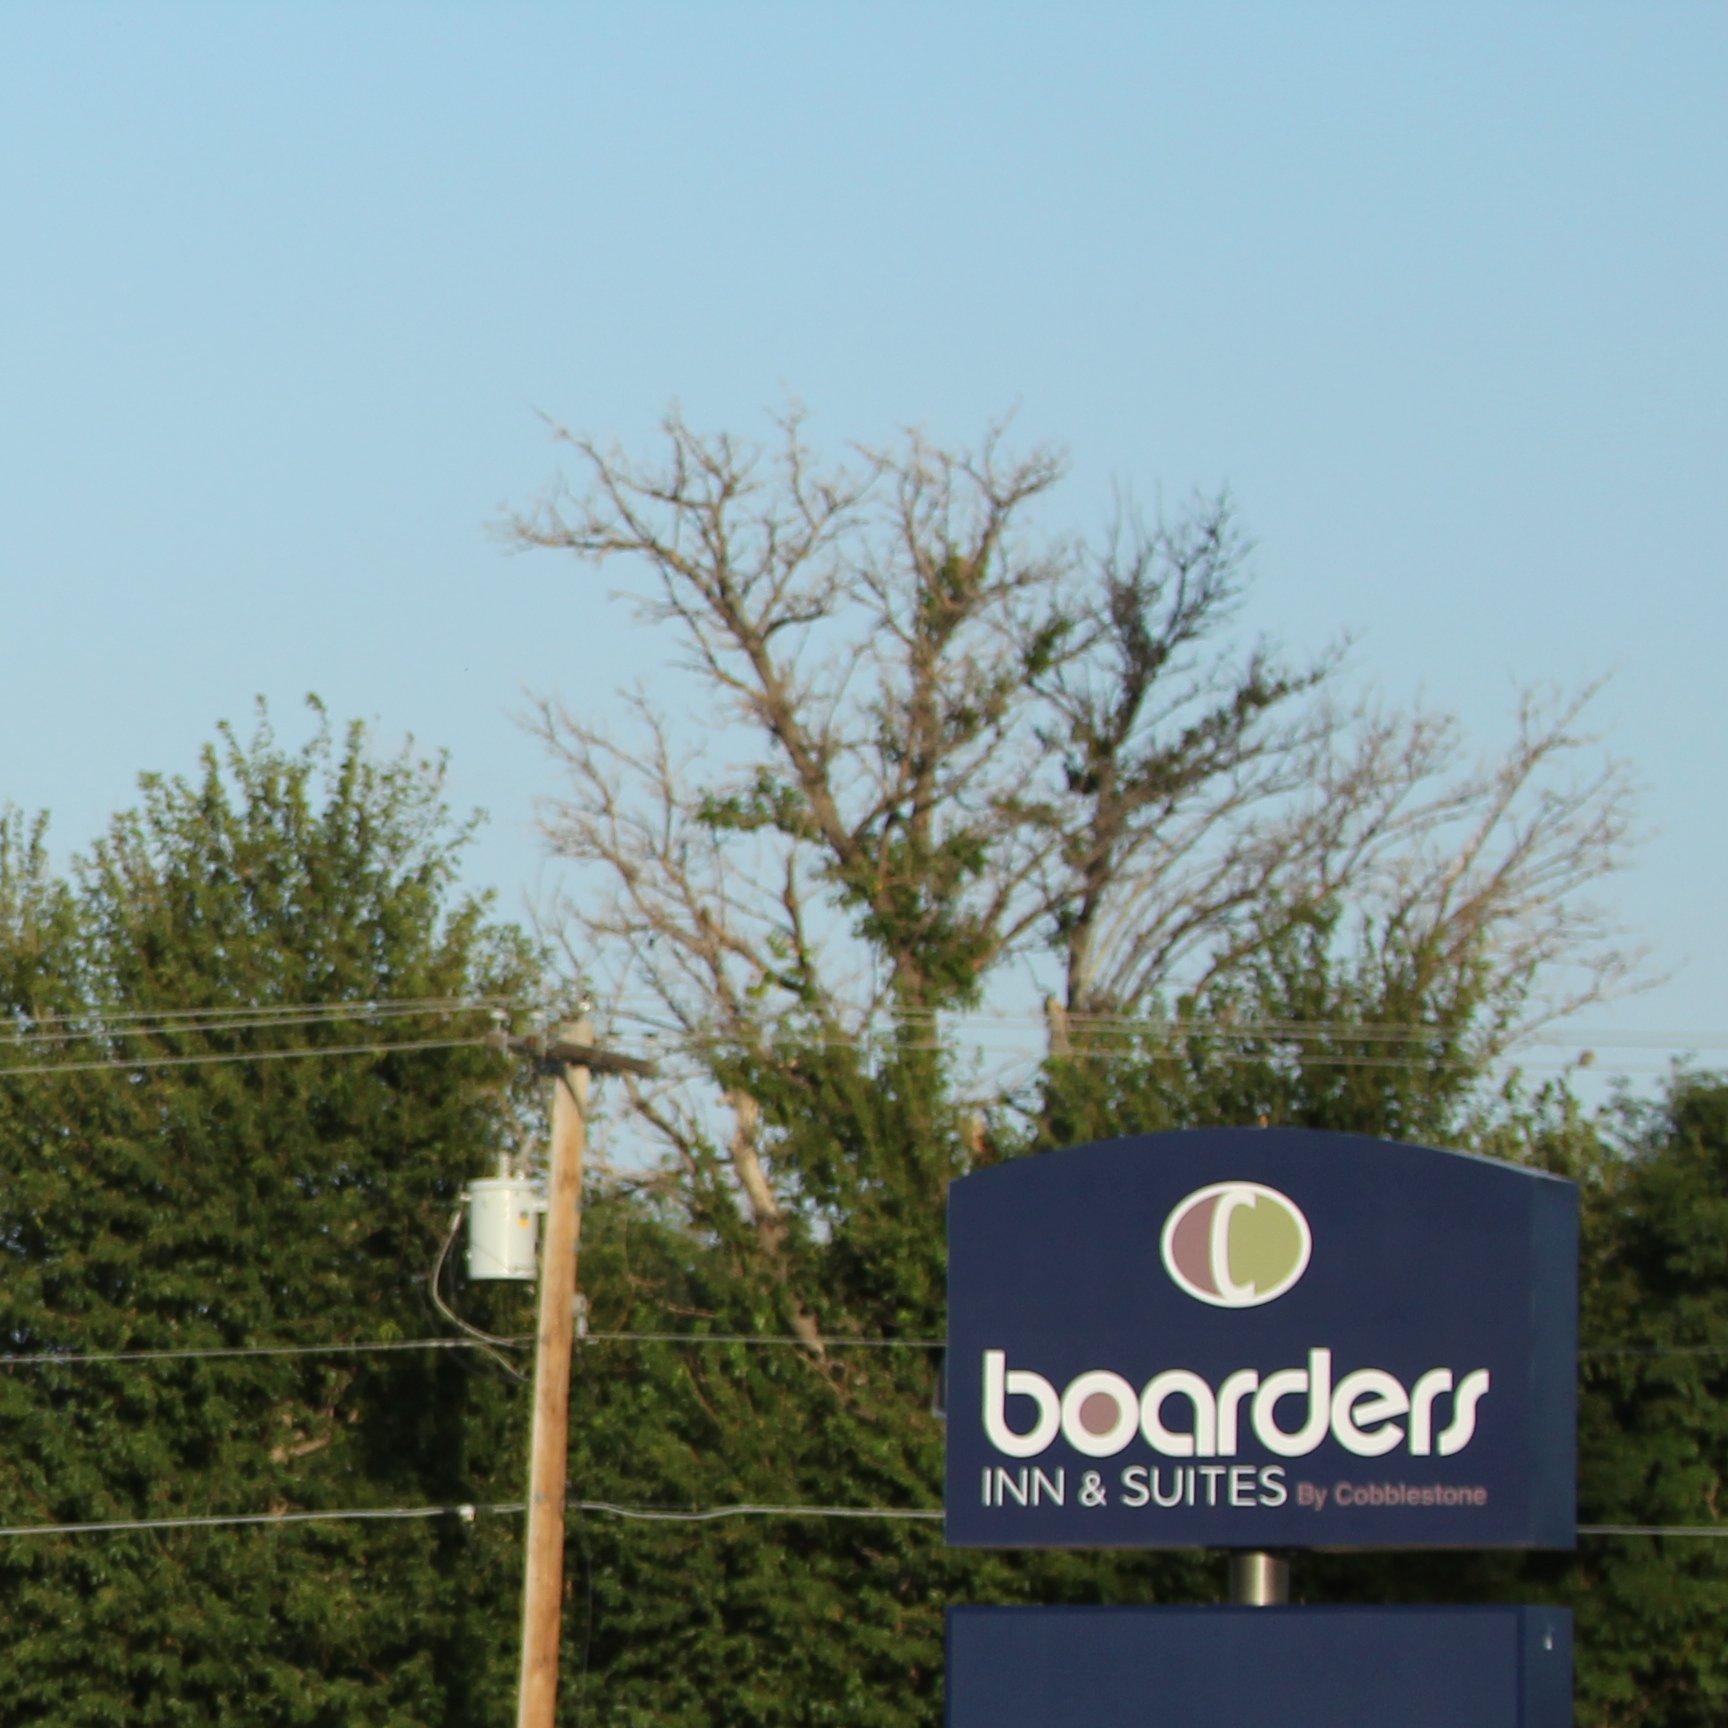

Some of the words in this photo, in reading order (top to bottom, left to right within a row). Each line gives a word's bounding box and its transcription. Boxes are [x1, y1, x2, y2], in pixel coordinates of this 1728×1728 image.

[983, 1347, 1490, 1458] boarders
[982, 1466, 1065, 1506] INN
[1079, 1470, 1107, 1507] &
[1120, 1465, 1289, 1507] SUITES
[1297, 1481, 1328, 1512] By
[1335, 1481, 1488, 1506] Cobblestone
